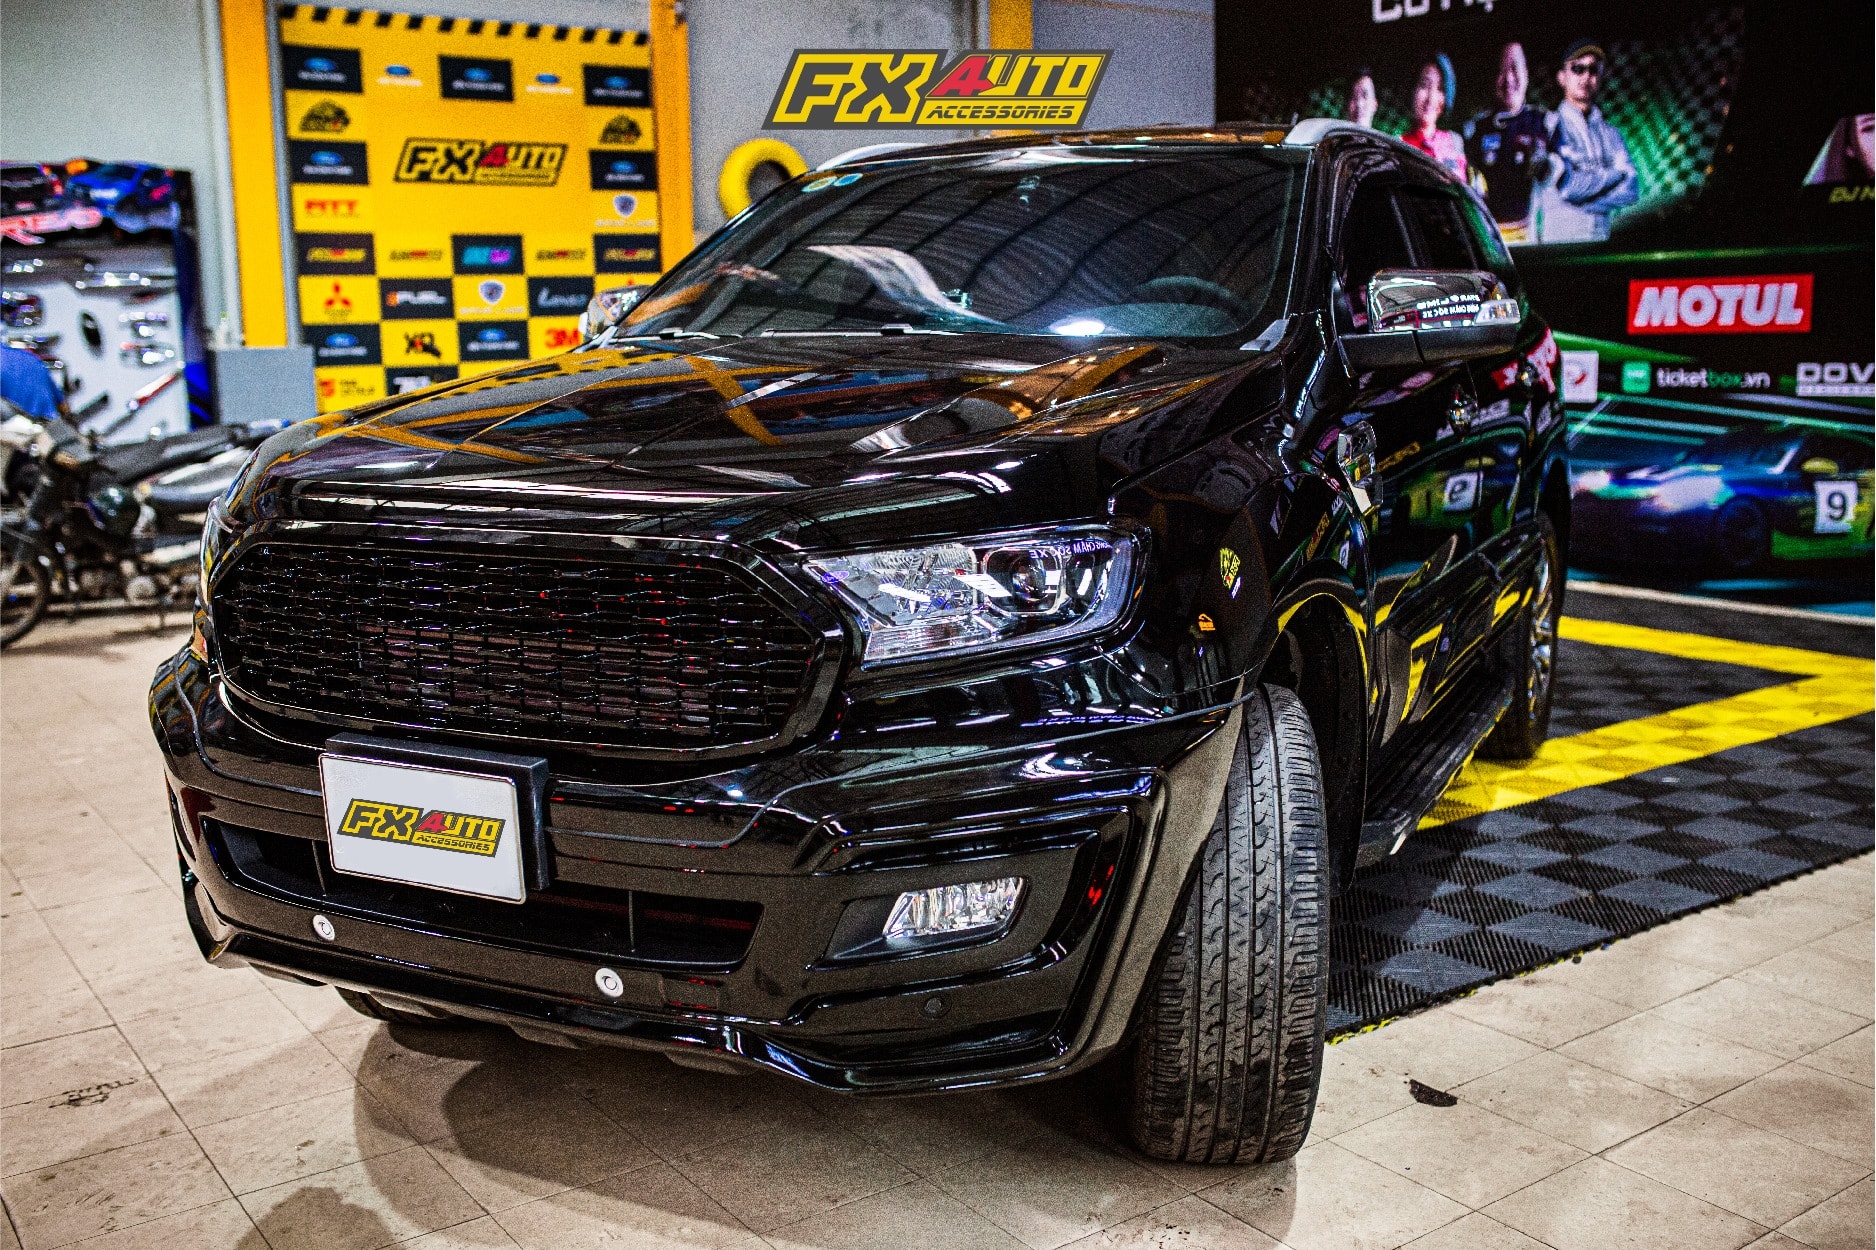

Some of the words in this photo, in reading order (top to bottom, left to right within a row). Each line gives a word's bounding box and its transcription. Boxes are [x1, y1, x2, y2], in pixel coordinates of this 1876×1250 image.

[1633, 282, 1804, 327] MOTUL
[545, 328, 581, 350] 3M
[1656, 367, 1771, 388] ticketbox.vn
[1828, 491, 1847, 521] 9
